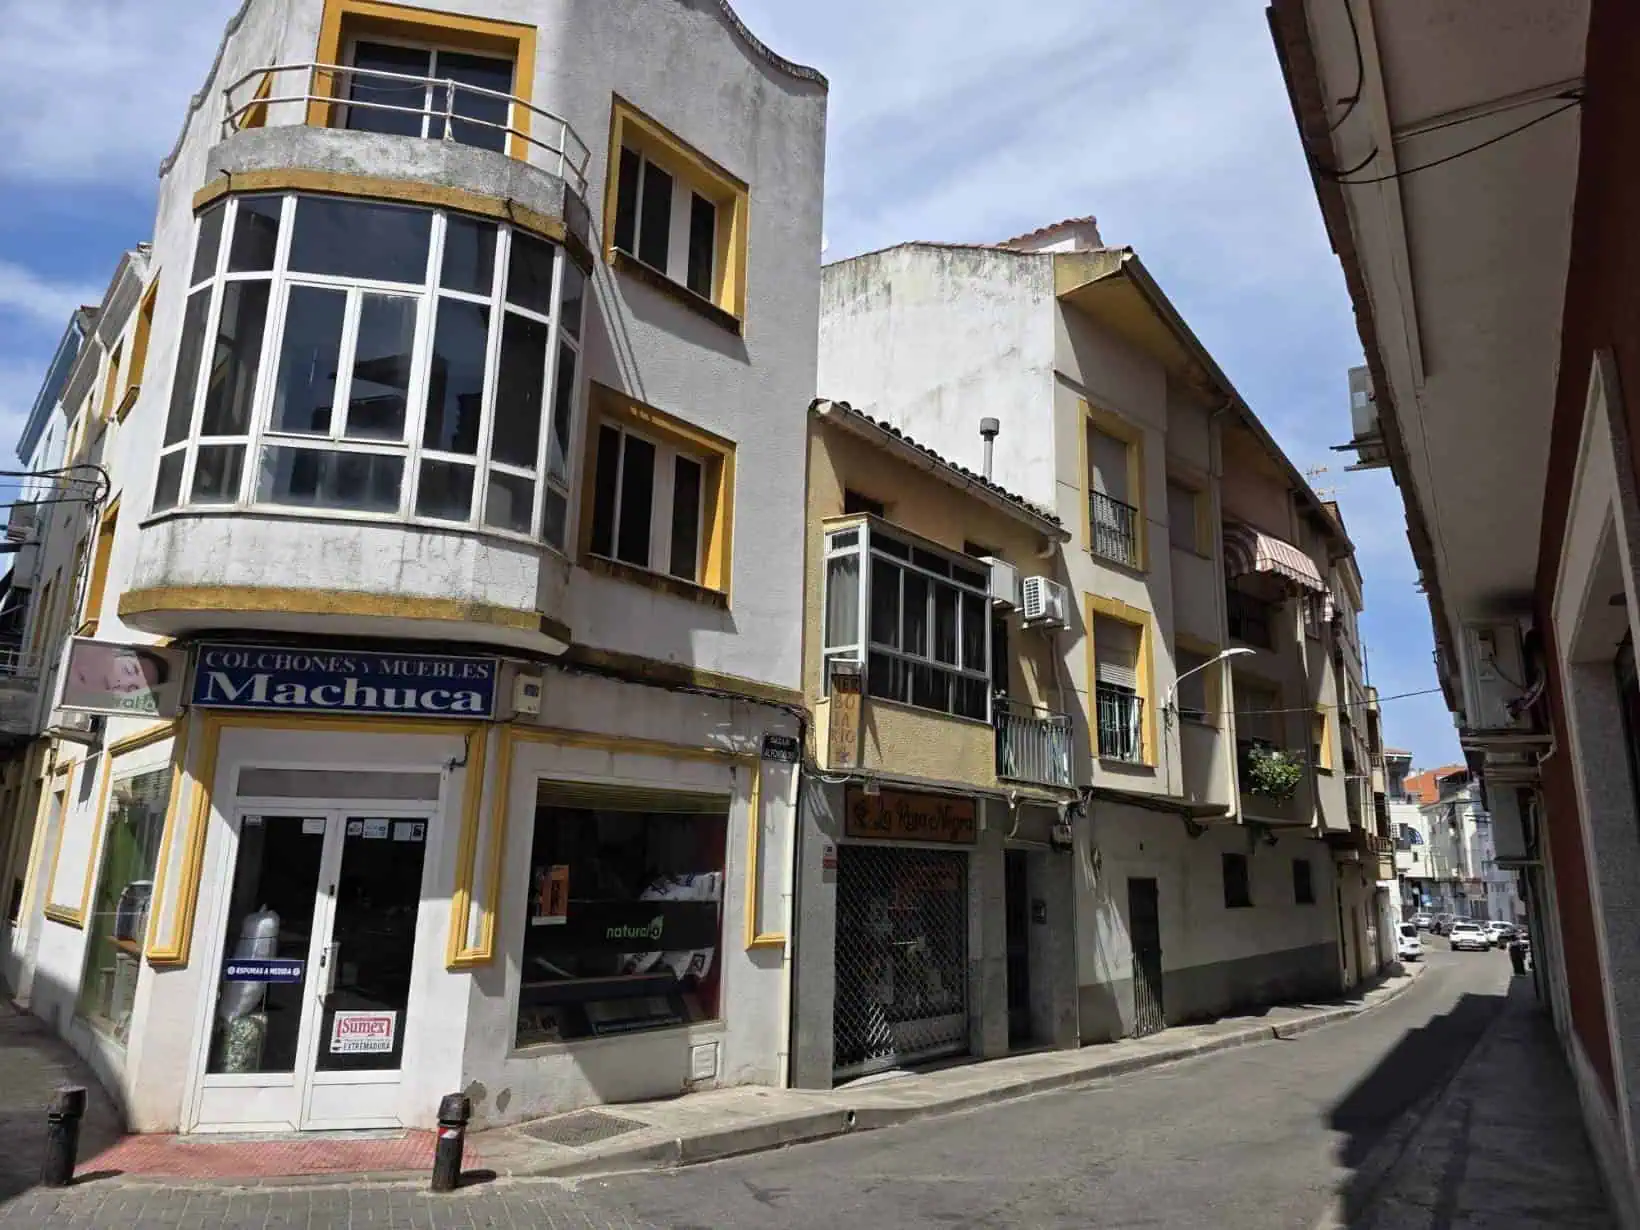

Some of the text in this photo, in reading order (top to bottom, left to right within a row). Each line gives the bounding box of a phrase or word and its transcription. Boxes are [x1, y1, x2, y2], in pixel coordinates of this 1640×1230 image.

[205, 651, 356, 673] COLCHONES
[379, 658, 490, 679] MUEBLES
[202, 671, 485, 712] Machuca
[342, 1018, 386, 1034] Sumex
